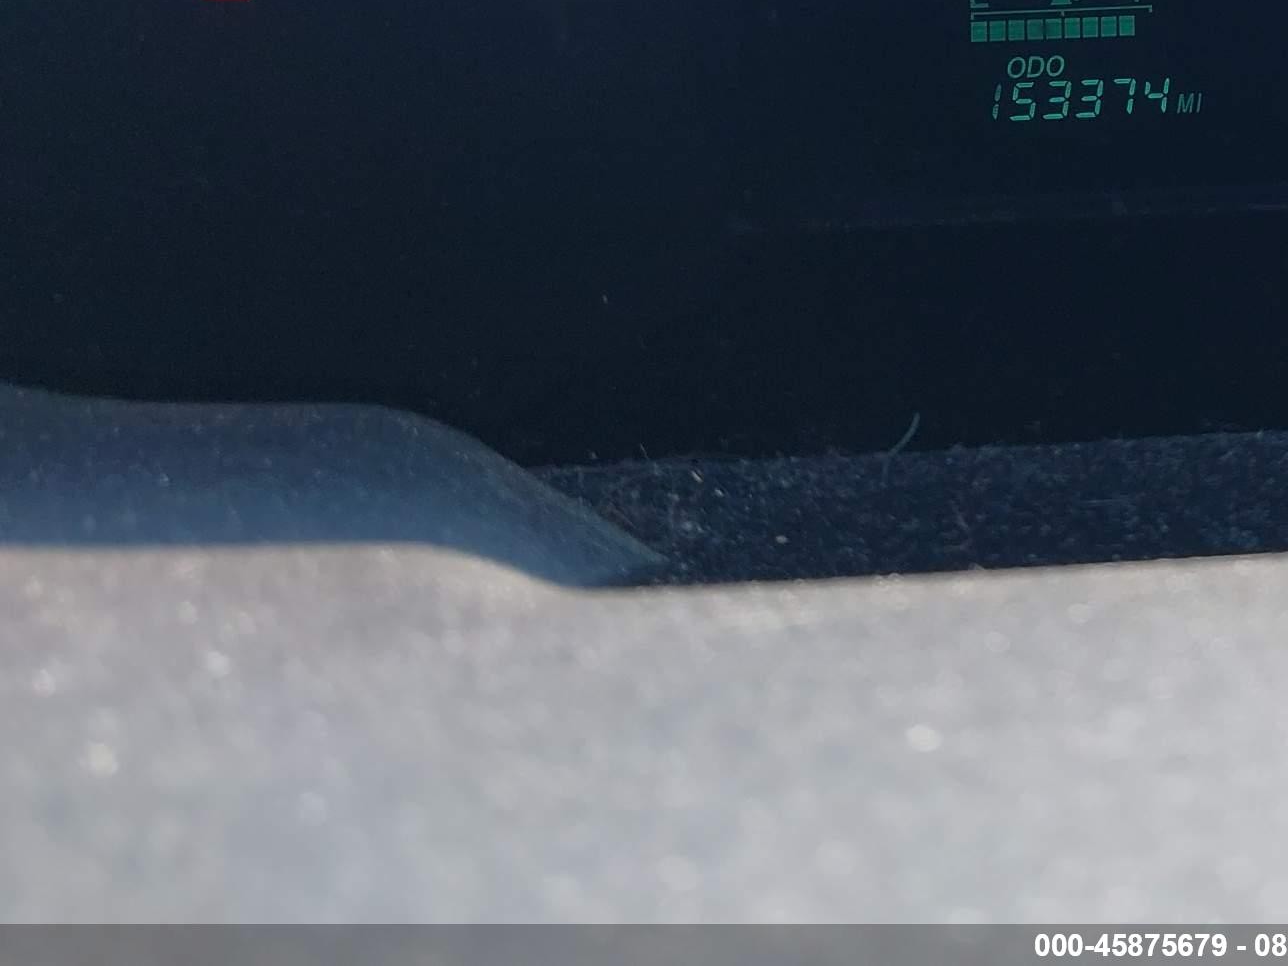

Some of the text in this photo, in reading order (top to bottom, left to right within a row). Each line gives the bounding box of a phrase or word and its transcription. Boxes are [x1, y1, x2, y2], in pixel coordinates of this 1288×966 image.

[1007, 54, 1066, 79] ODO
[991, 78, 1203, 122] 153374 MI
